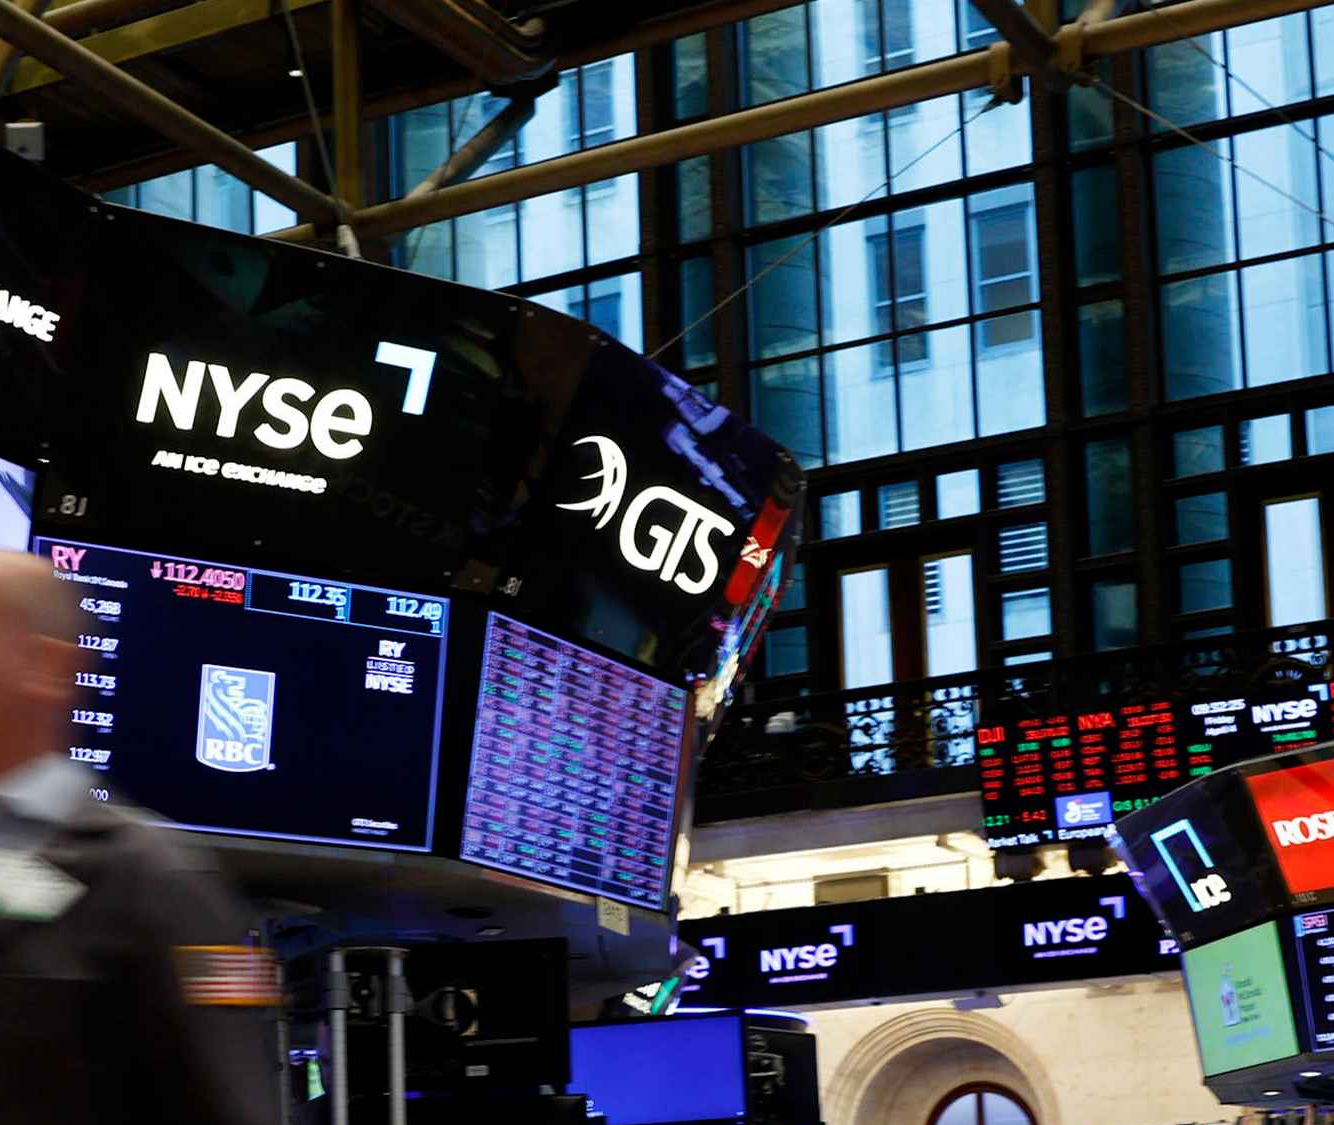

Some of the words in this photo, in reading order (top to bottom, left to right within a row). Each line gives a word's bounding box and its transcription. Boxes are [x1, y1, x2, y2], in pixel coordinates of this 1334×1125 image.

[619, 485, 736, 594] GTS
[51, 545, 86, 571] RY
[164, 563, 246, 590] 112.4050
[288, 582, 347, 606] 112.35
[385, 597, 443, 620] 112.49
[379, 639, 406, 658] RY
[365, 674, 413, 694] NYSE
[205, 738, 262, 765] RBC
